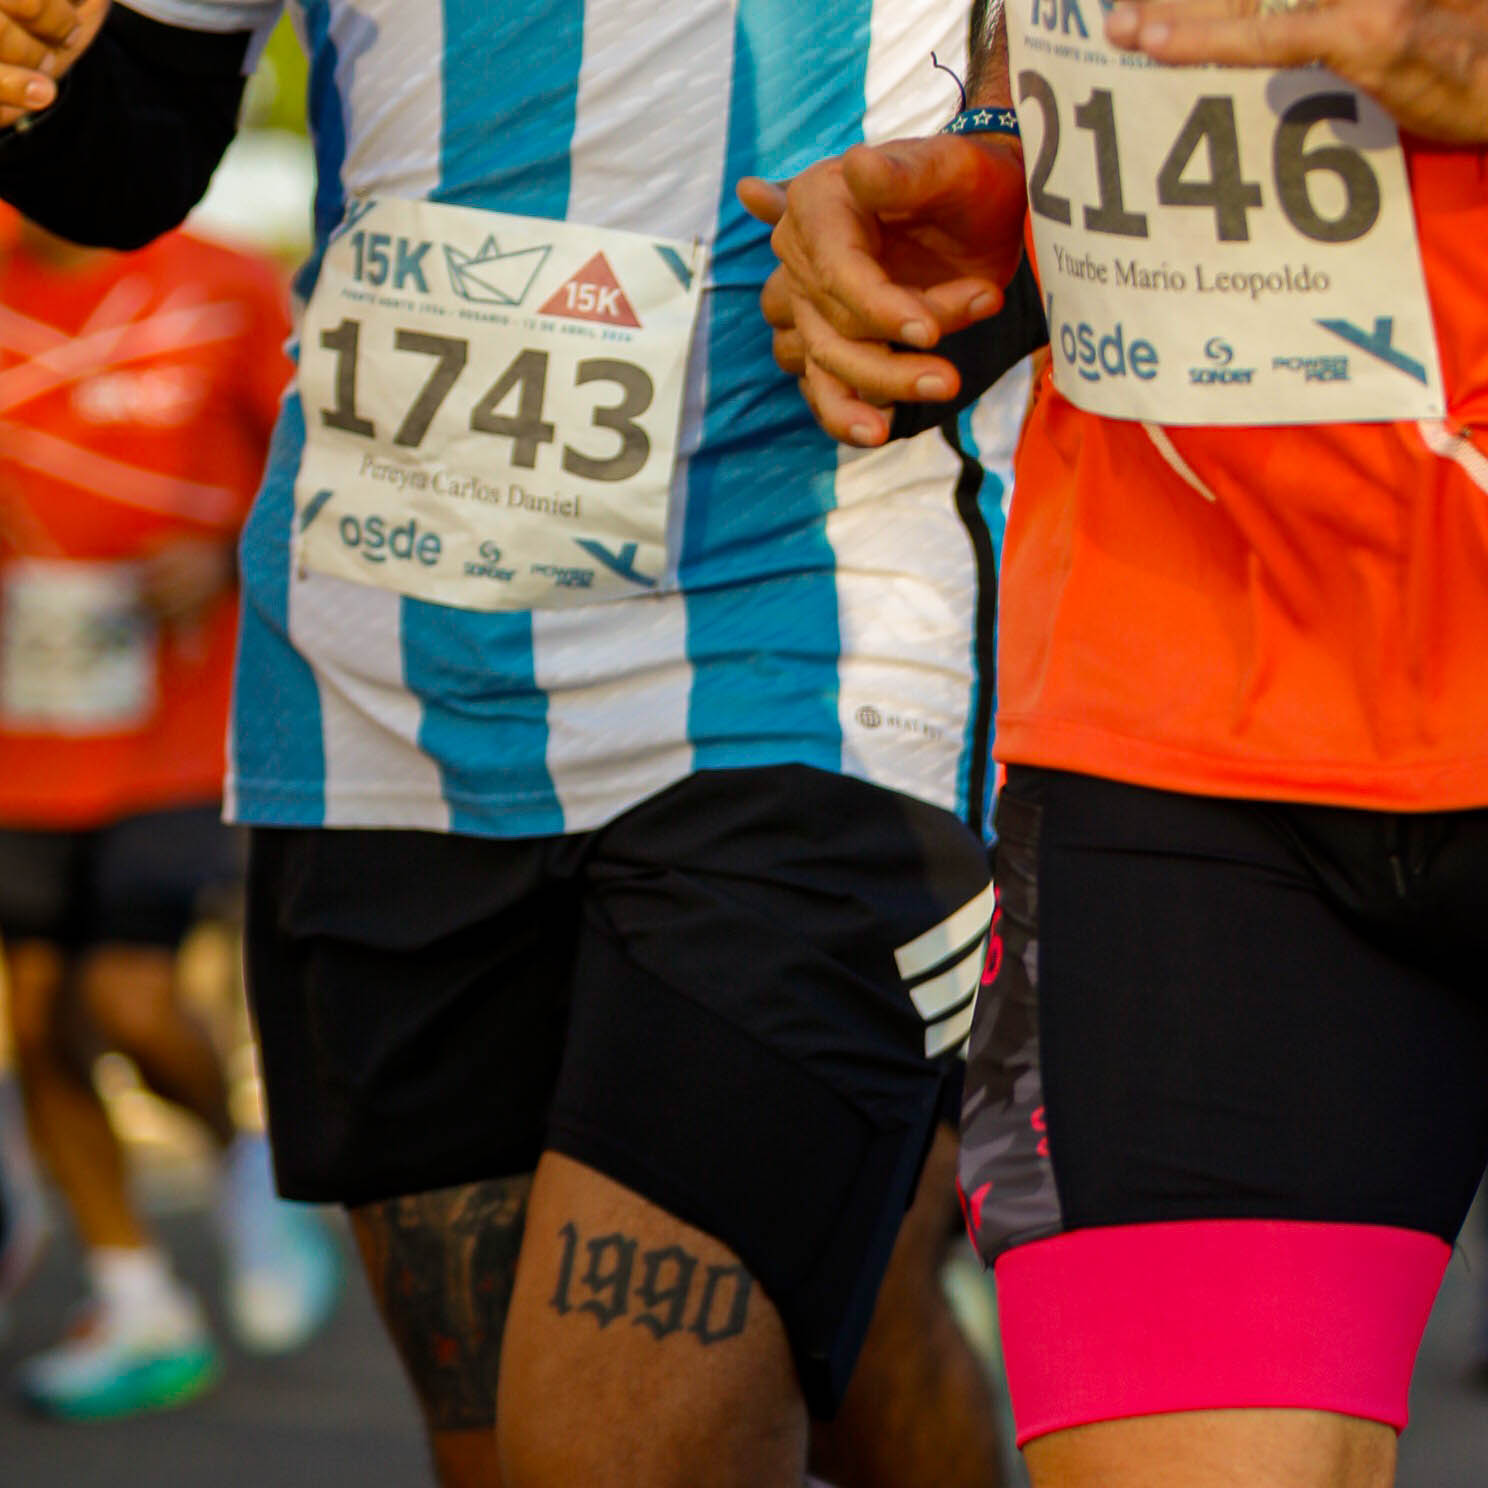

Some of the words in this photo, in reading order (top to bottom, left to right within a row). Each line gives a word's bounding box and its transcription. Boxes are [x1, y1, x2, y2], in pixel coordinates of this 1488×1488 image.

[1017, 68, 1383, 245] 2146
[349, 229, 434, 295] 15K
[565, 282, 622, 317] 15K
[1053, 243, 1107, 284] Yturbe
[1114, 258, 1187, 291] Mario
[1195, 262, 1330, 301] Leopoldo
[1060, 323, 1159, 381] osde
[319, 318, 655, 483] 1743
[359, 454, 428, 491] Pereyra
[431, 471, 501, 504] Carlos
[508, 484, 581, 518] Daniel
[339, 513, 442, 565] osde
[548, 1220, 752, 1346] 1990
